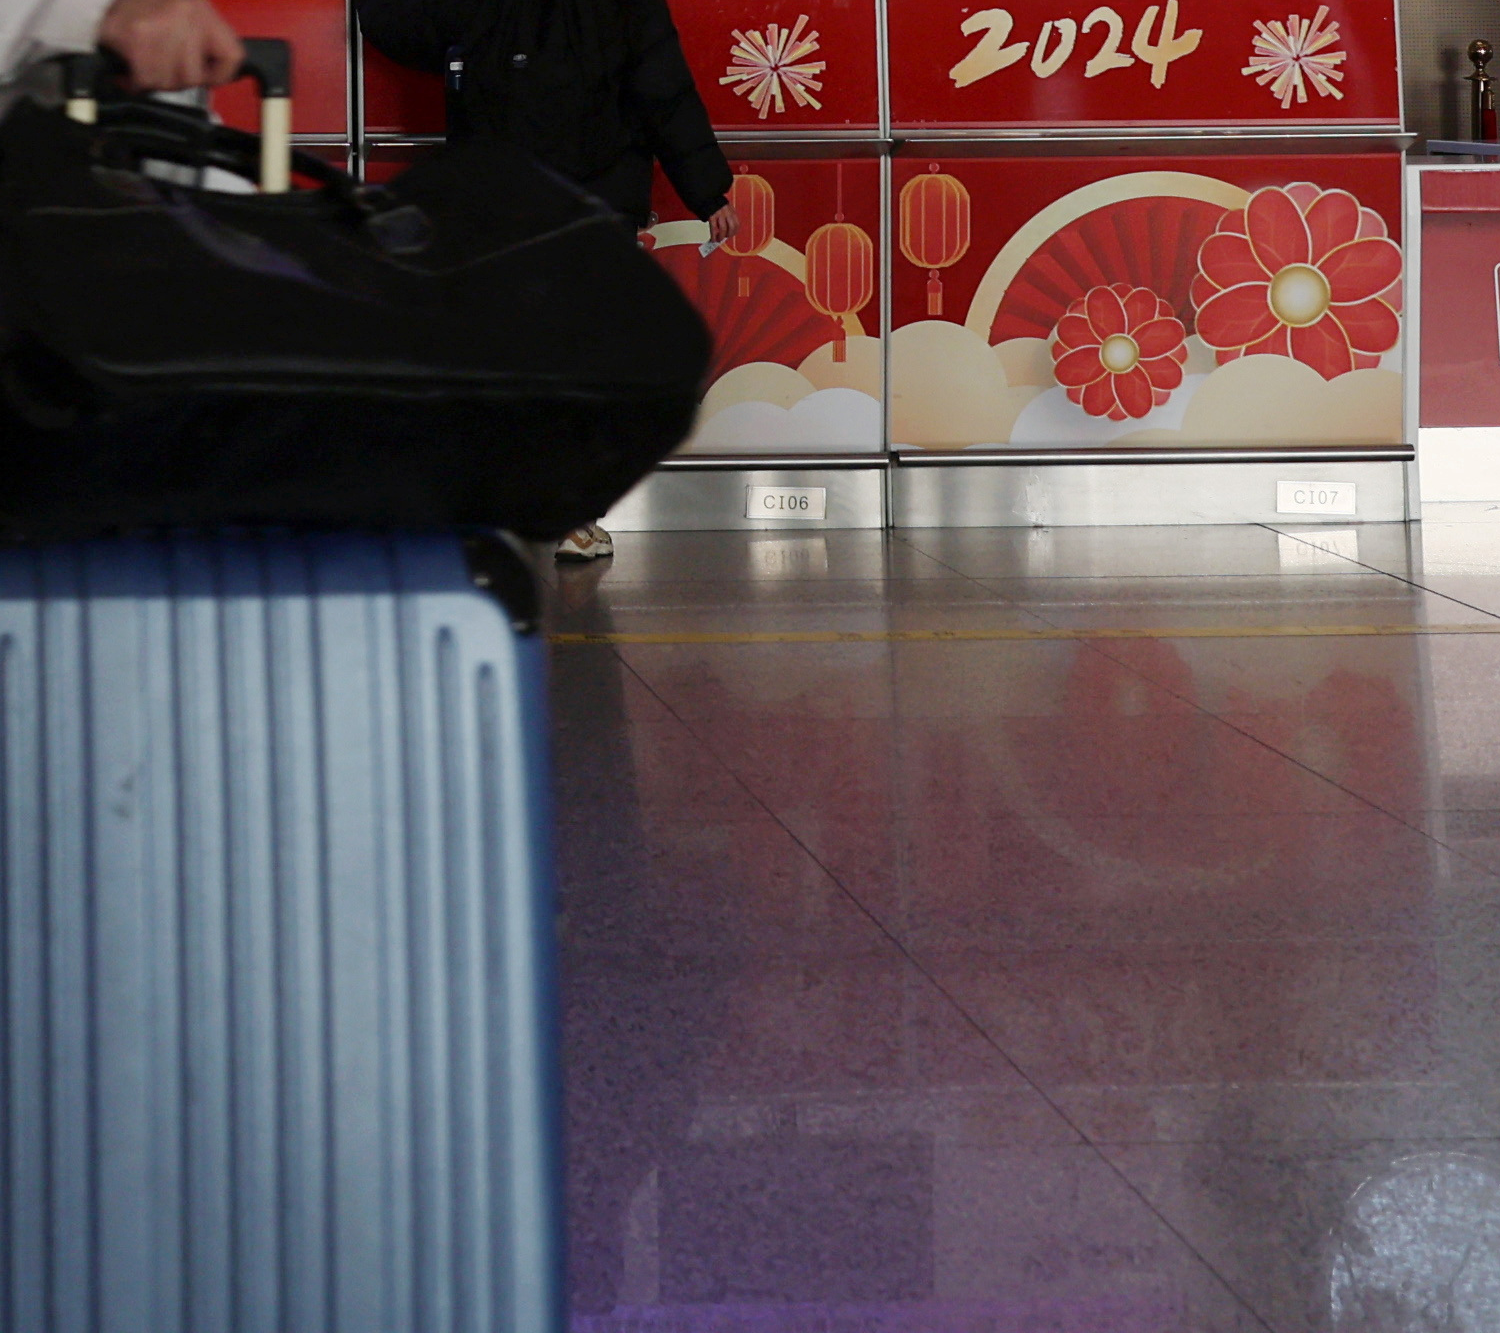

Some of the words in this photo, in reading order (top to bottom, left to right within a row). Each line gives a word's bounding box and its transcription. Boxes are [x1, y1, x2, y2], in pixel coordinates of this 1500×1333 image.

[950, 0, 1202, 89] 2024
[763, 494, 809, 510] CI06
[1294, 489, 1340, 505] CI07
